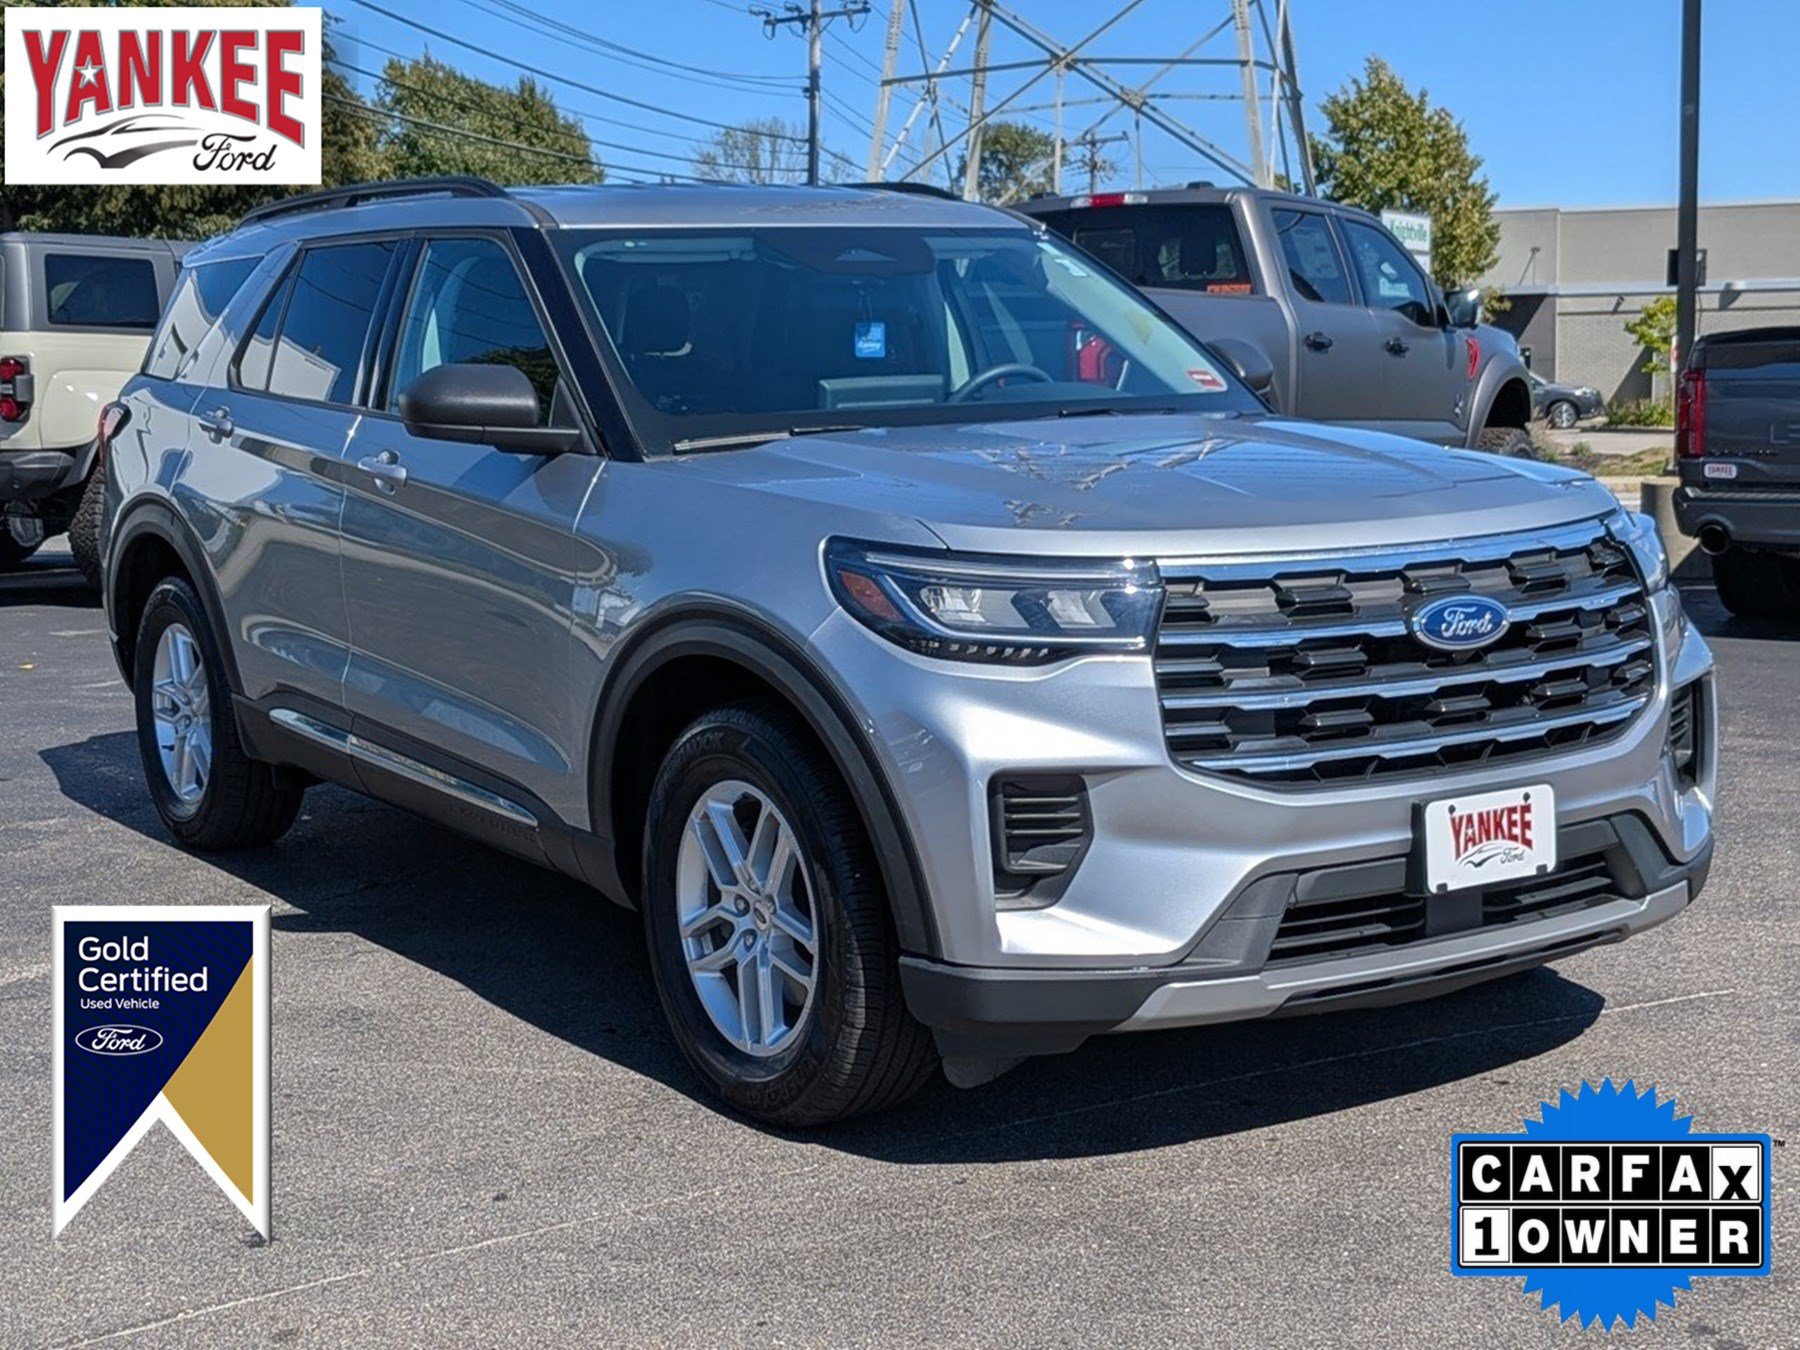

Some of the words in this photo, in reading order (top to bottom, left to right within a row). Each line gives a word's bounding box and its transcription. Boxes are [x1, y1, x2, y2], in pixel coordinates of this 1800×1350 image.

[1441, 605, 1493, 638] Ford
[1450, 803, 1533, 861] YANKEE
[1500, 846, 1525, 864] Ford
